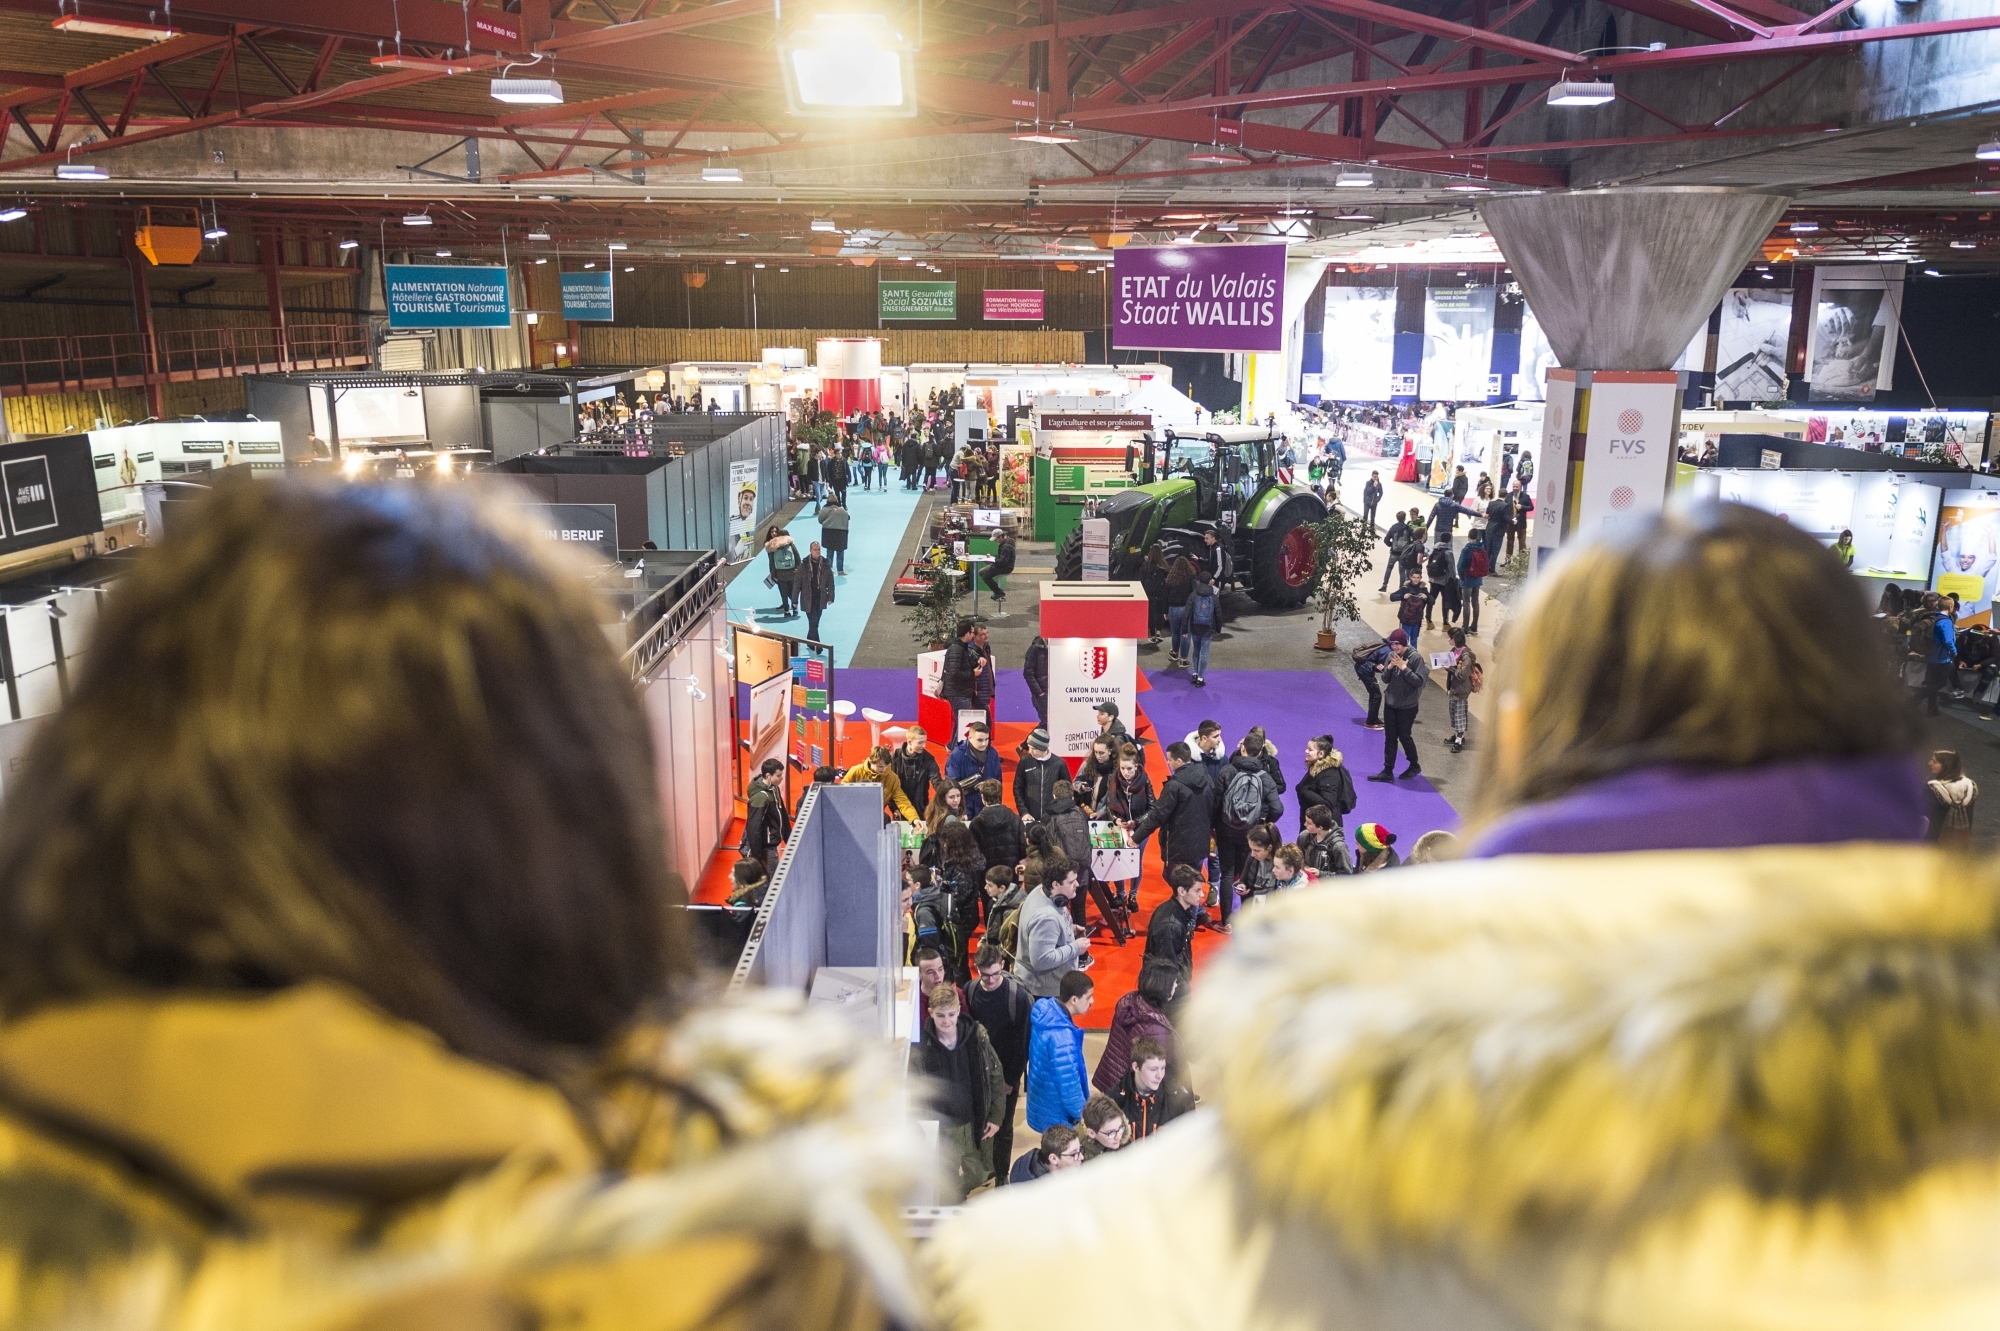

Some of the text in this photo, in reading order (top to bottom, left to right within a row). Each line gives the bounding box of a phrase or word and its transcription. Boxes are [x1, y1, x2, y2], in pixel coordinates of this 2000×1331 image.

[476, 21, 517, 39] MAX 800 KG
[392, 282, 504, 295] ALIMENTATION Nahrung
[1121, 272, 1276, 298] ETAT du Valais
[392, 293, 504, 302] Hôtellerie GASTRONOMIE
[882, 296, 910, 306] Social
[392, 303, 506, 313] TOURISME Tourismus
[1120, 300, 1274, 326] Staat WALLIS
[1048, 419, 1088, 428] L'agriculture
[1108, 418, 1144, 428] professions
[1609, 440, 1645, 454] FVS
[18, 486, 30, 496] AVE
[1543, 508, 1556, 524] FVS
[561, 530, 604, 541] BERUF
[1065, 730, 1099, 742] FORMATION
